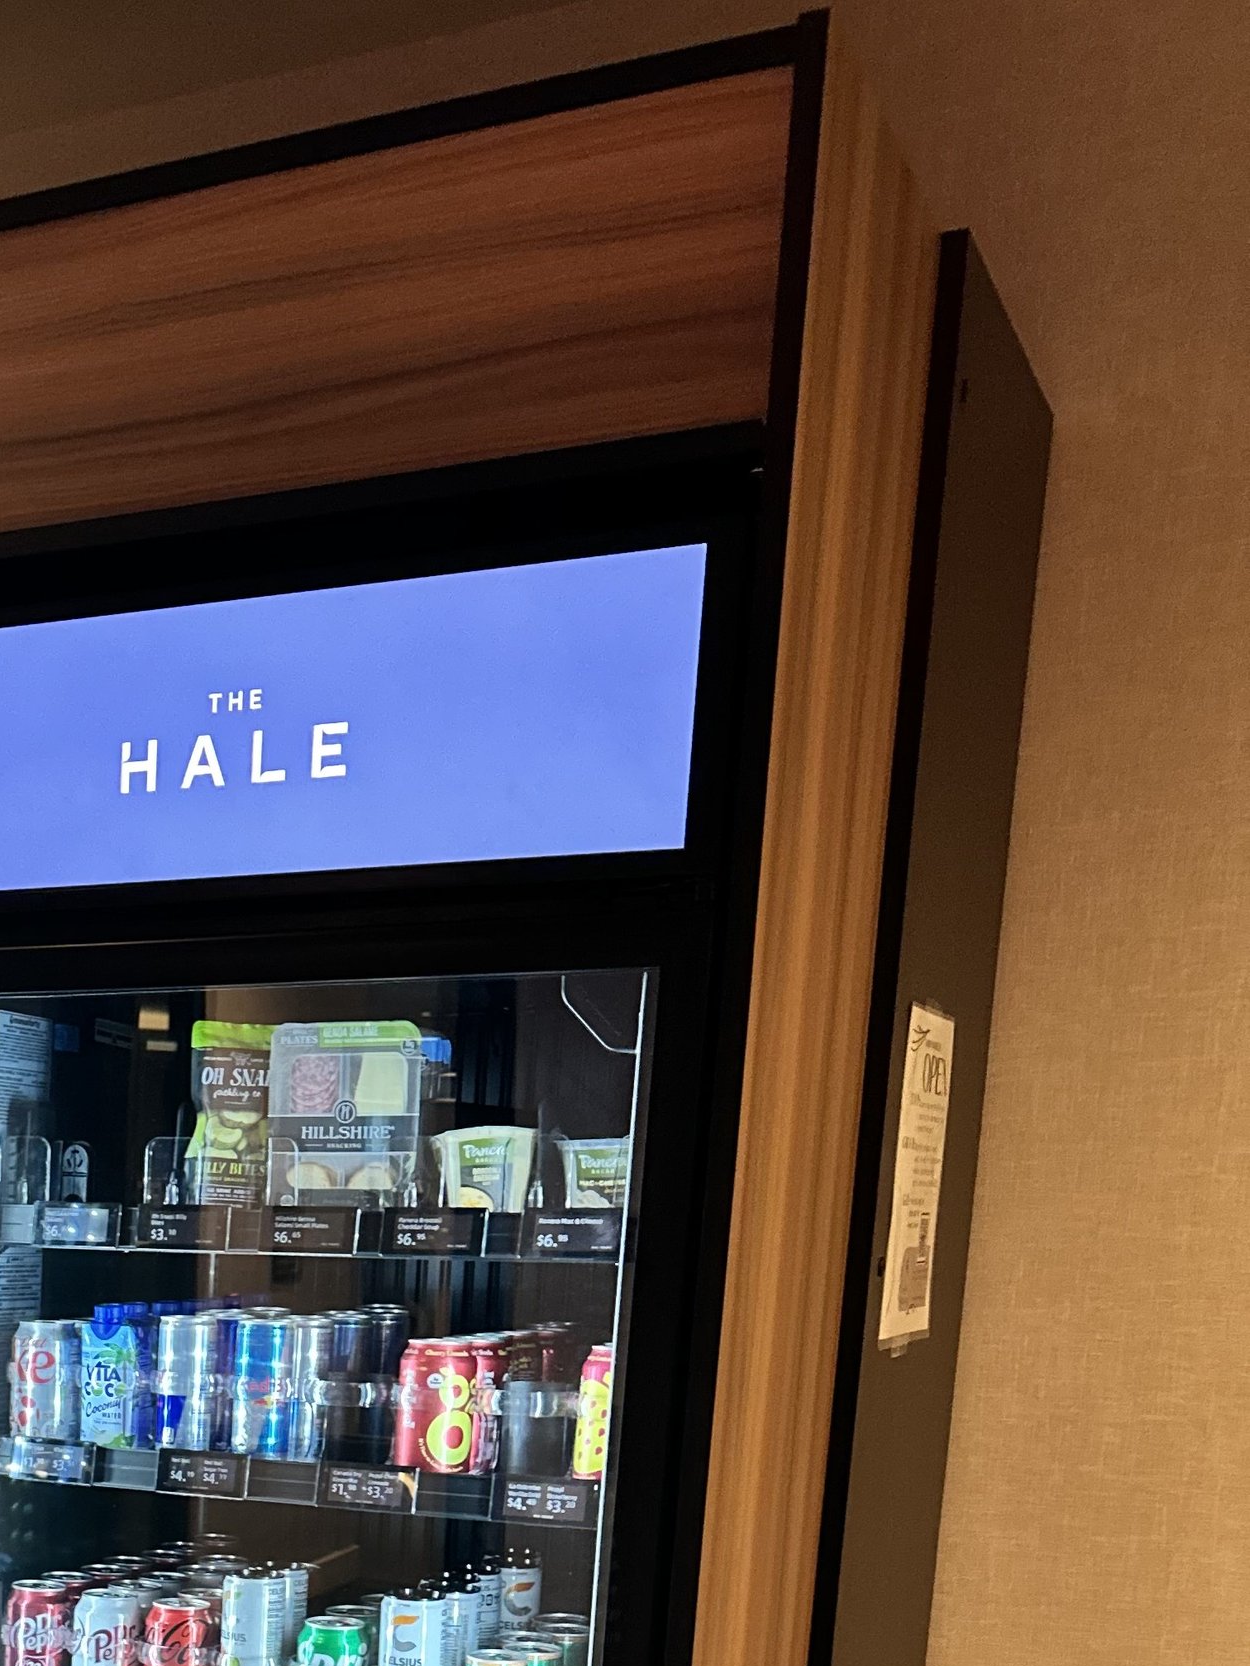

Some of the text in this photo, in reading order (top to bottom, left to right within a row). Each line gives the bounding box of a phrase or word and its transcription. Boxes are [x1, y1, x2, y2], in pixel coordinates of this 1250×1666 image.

[208, 688, 263, 714] THE
[120, 721, 349, 794] HALE
[280, 1034, 318, 1046] PLATES
[201, 1066, 224, 1086] OH
[301, 1125, 391, 1140] HILLSHIRE
[86, 1360, 122, 1382] VITA
